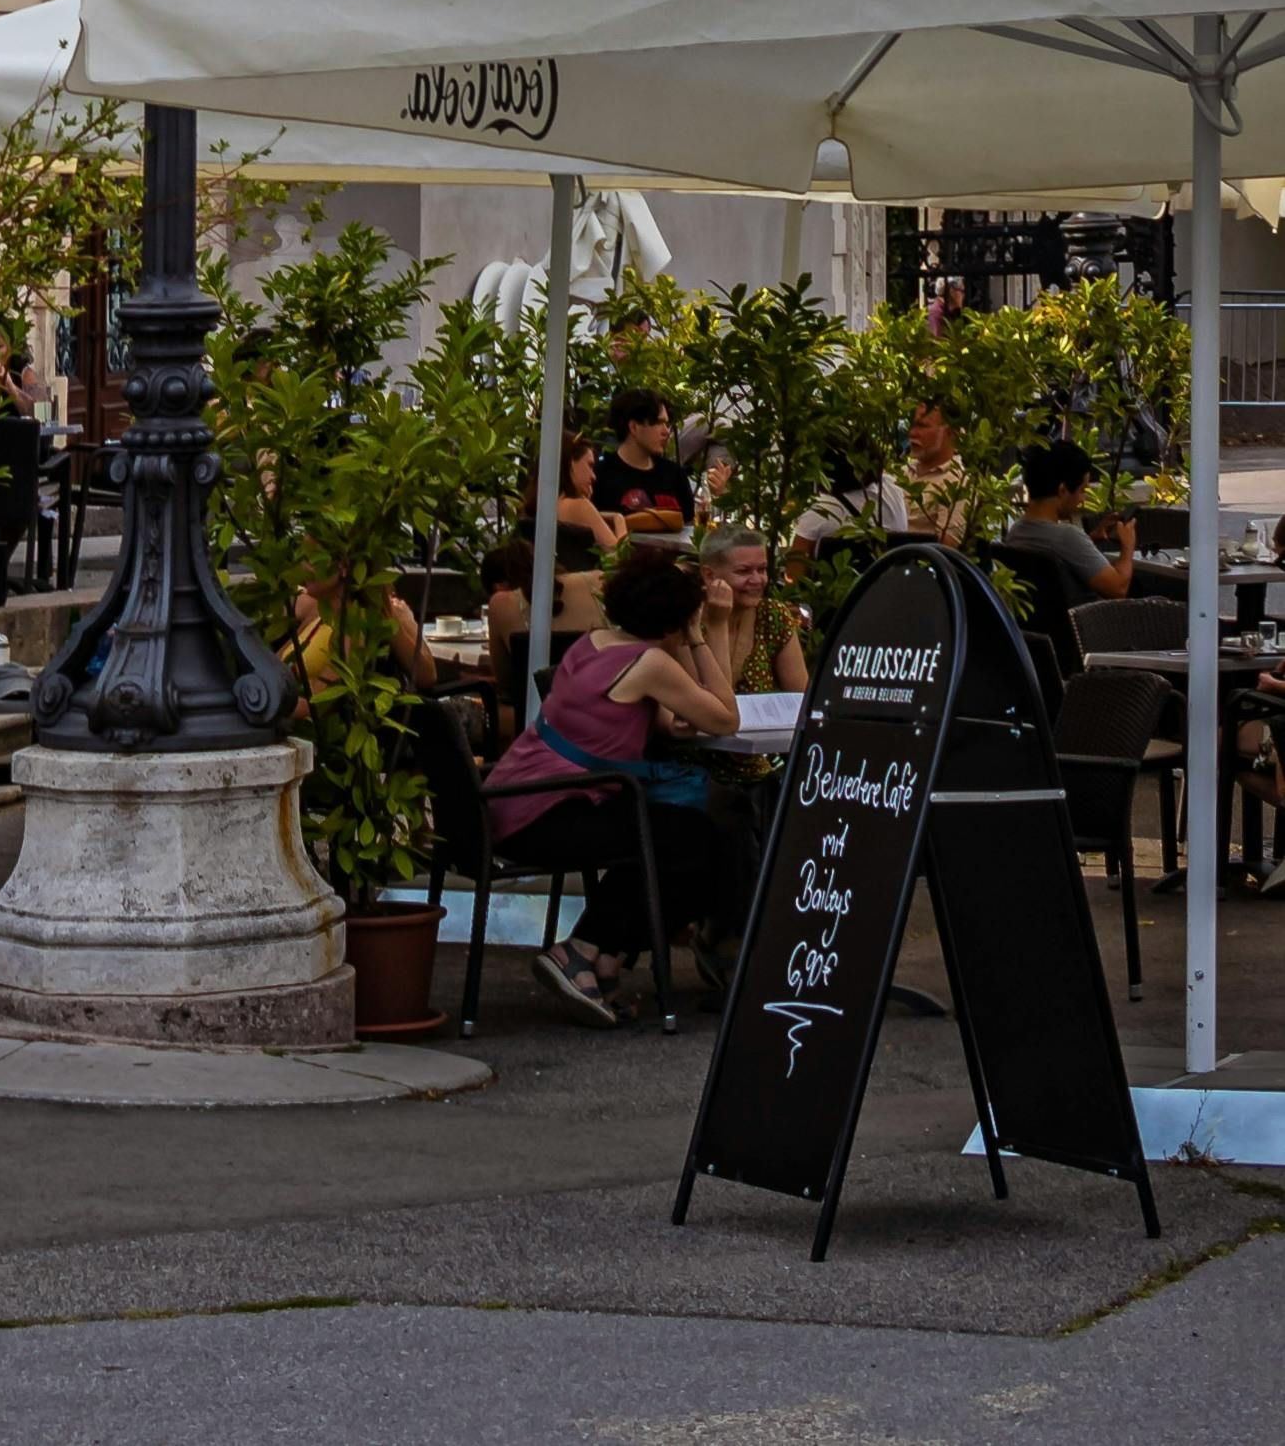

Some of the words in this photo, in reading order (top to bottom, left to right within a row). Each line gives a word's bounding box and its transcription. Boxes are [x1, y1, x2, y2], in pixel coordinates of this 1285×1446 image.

[834, 642, 941, 682] SCHLOSSCAFÉ
[843, 686, 852, 699] IM
[878, 687, 914, 703] BELVEDERE
[799, 742, 881, 809] Belvedere
[882, 760, 918, 818] Café
[821, 817, 850, 858] mit
[795, 858, 853, 949] Baileys
[786, 940, 840, 997] 6,90€
